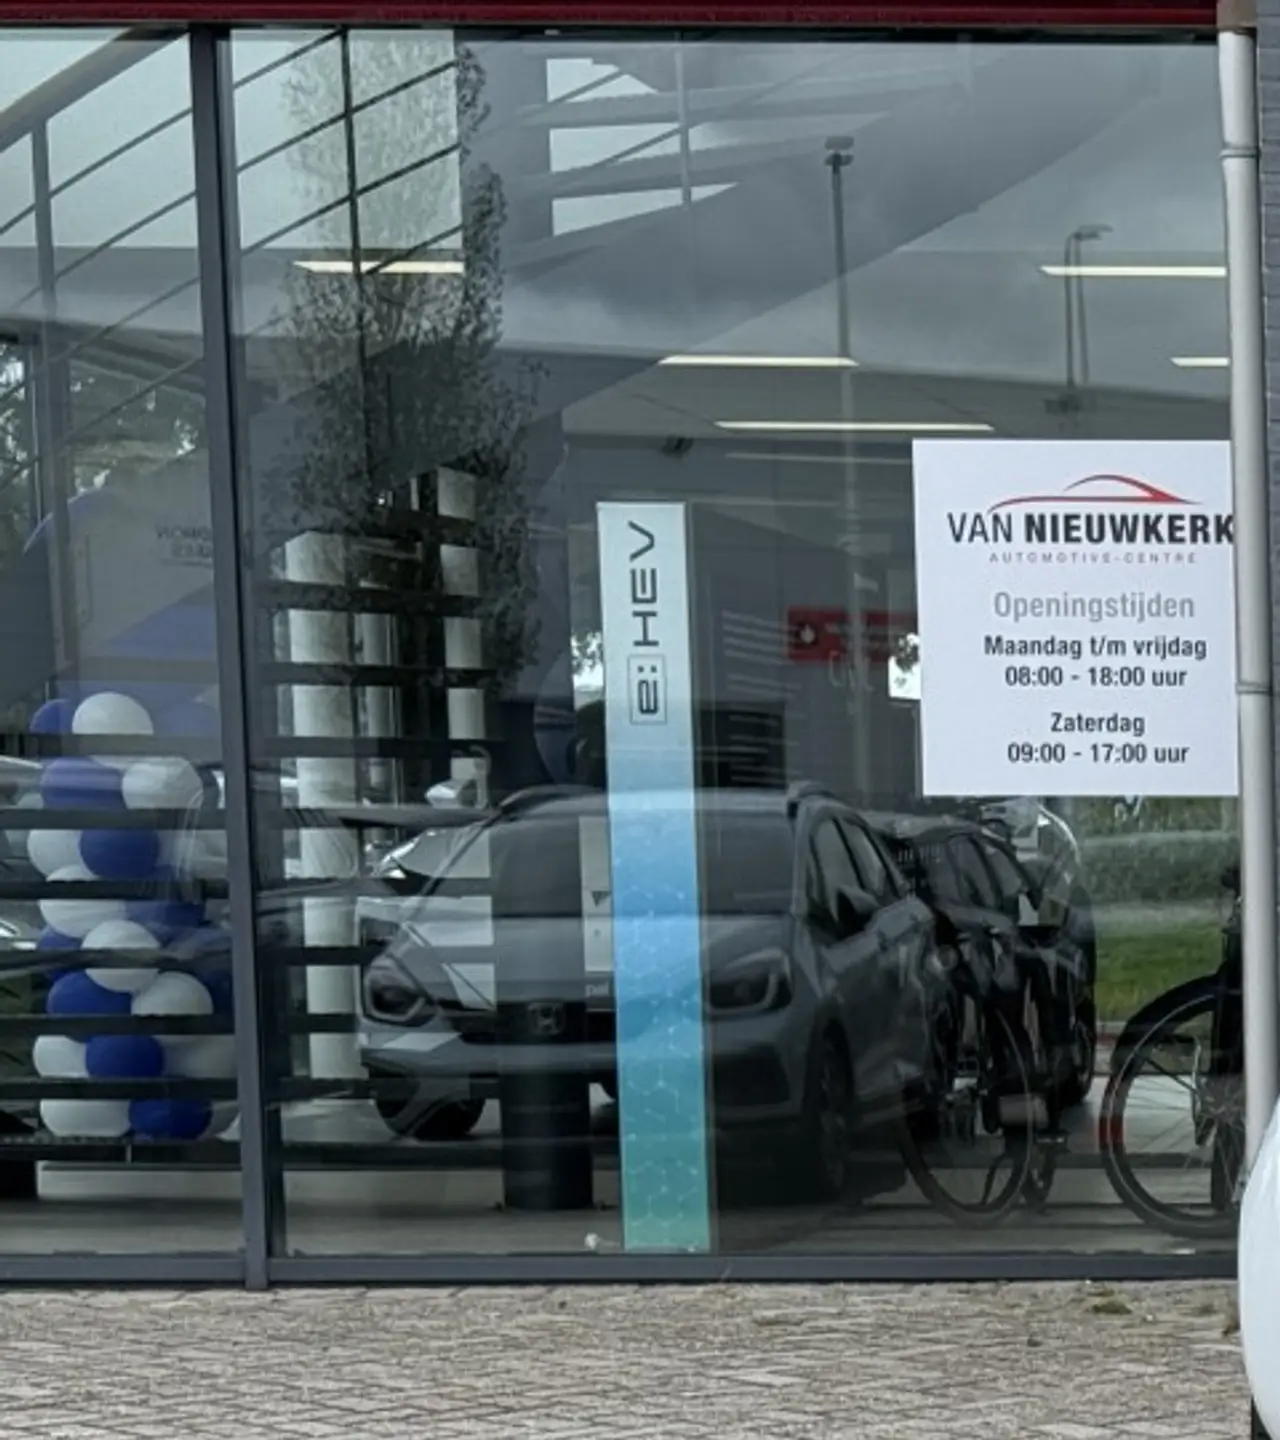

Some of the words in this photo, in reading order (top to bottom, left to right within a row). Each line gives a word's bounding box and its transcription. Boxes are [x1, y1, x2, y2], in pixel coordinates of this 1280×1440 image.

[947, 512, 1013, 544] VAN
[1024, 513, 1234, 545] NIEUWKERK
[989, 551, 1197, 564] AUTOMOTIVE-CENTRE
[993, 591, 1195, 622] Openingstijden
[984, 635, 1082, 660] Maandag
[1090, 636, 1126, 656] t/m
[1133, 635, 1207, 661] vrijdag
[1005, 666, 1063, 687] 08:00
[1088, 666, 1145, 687] 18:00
[1152, 669, 1188, 687] uur
[1050, 712, 1145, 736] Zaterdag
[1007, 743, 1066, 763] 09:00
[1090, 743, 1147, 763] 17:00
[1154, 747, 1190, 763] uur
